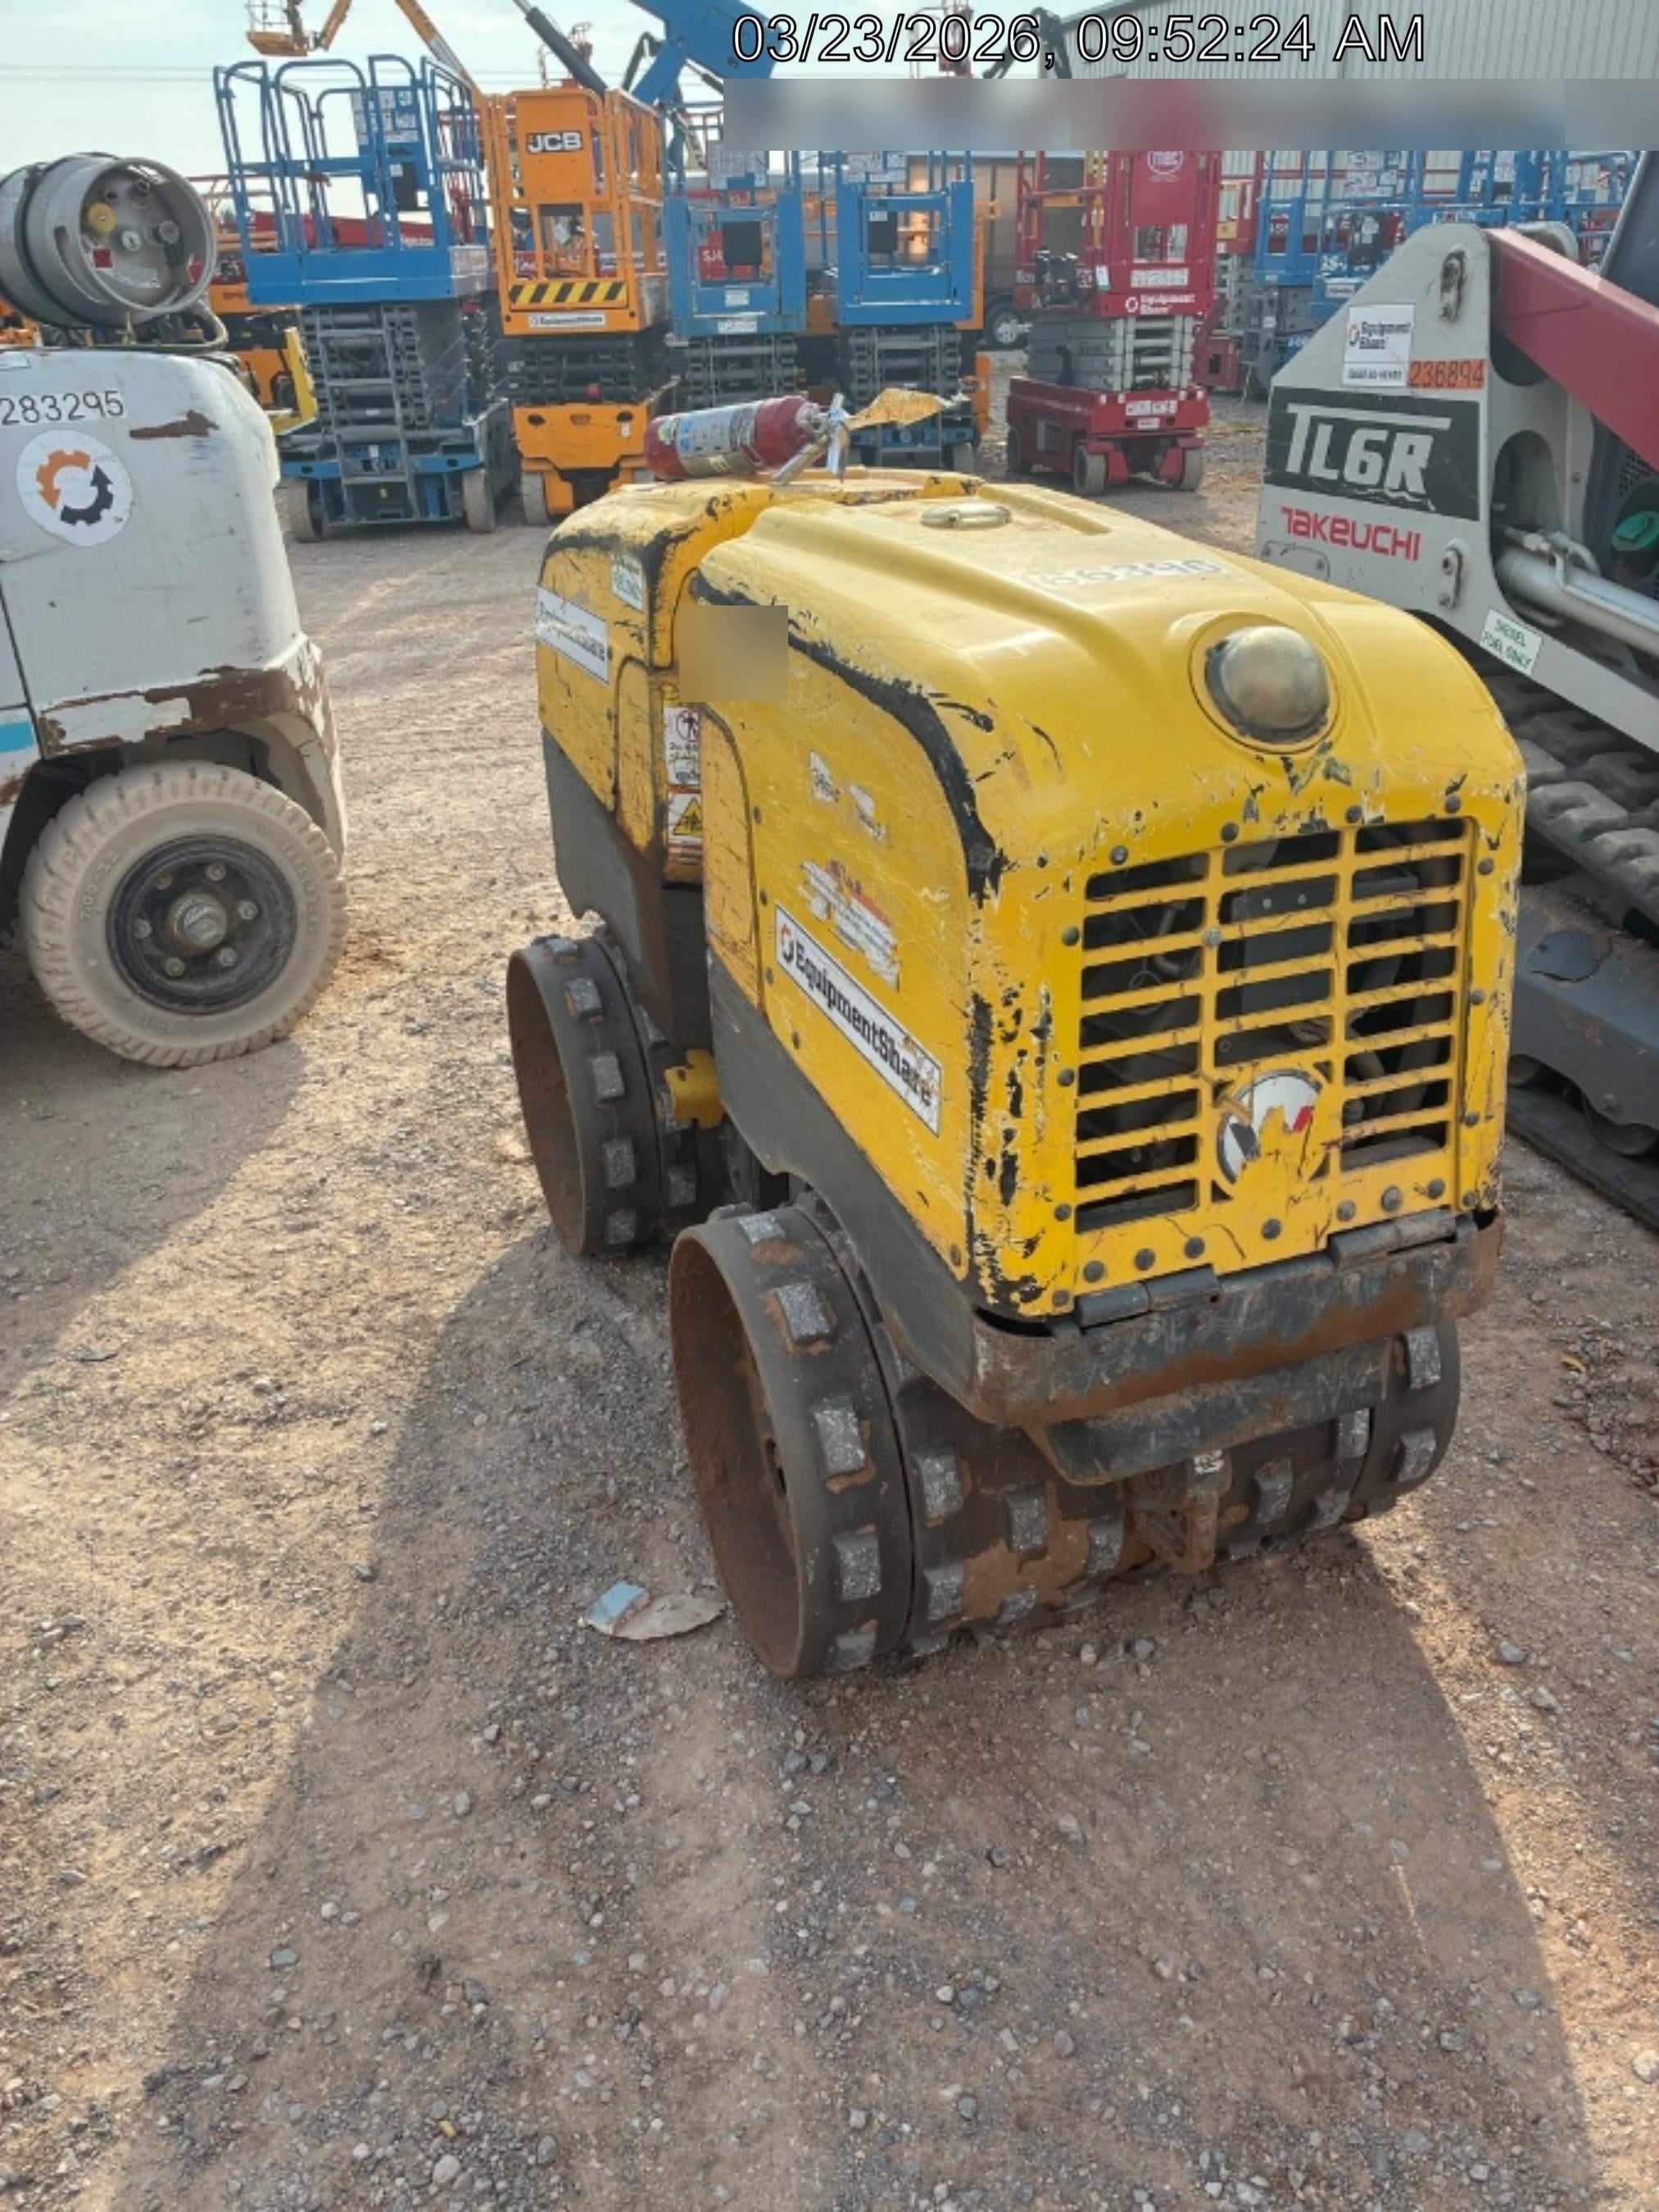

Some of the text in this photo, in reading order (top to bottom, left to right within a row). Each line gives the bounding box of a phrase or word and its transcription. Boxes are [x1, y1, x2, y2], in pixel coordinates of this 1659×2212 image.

[528, 133, 581, 153] JCB
[1407, 359, 1485, 388] 236894
[0, 390, 124, 425] 283295
[1285, 402, 1452, 495] TL6R
